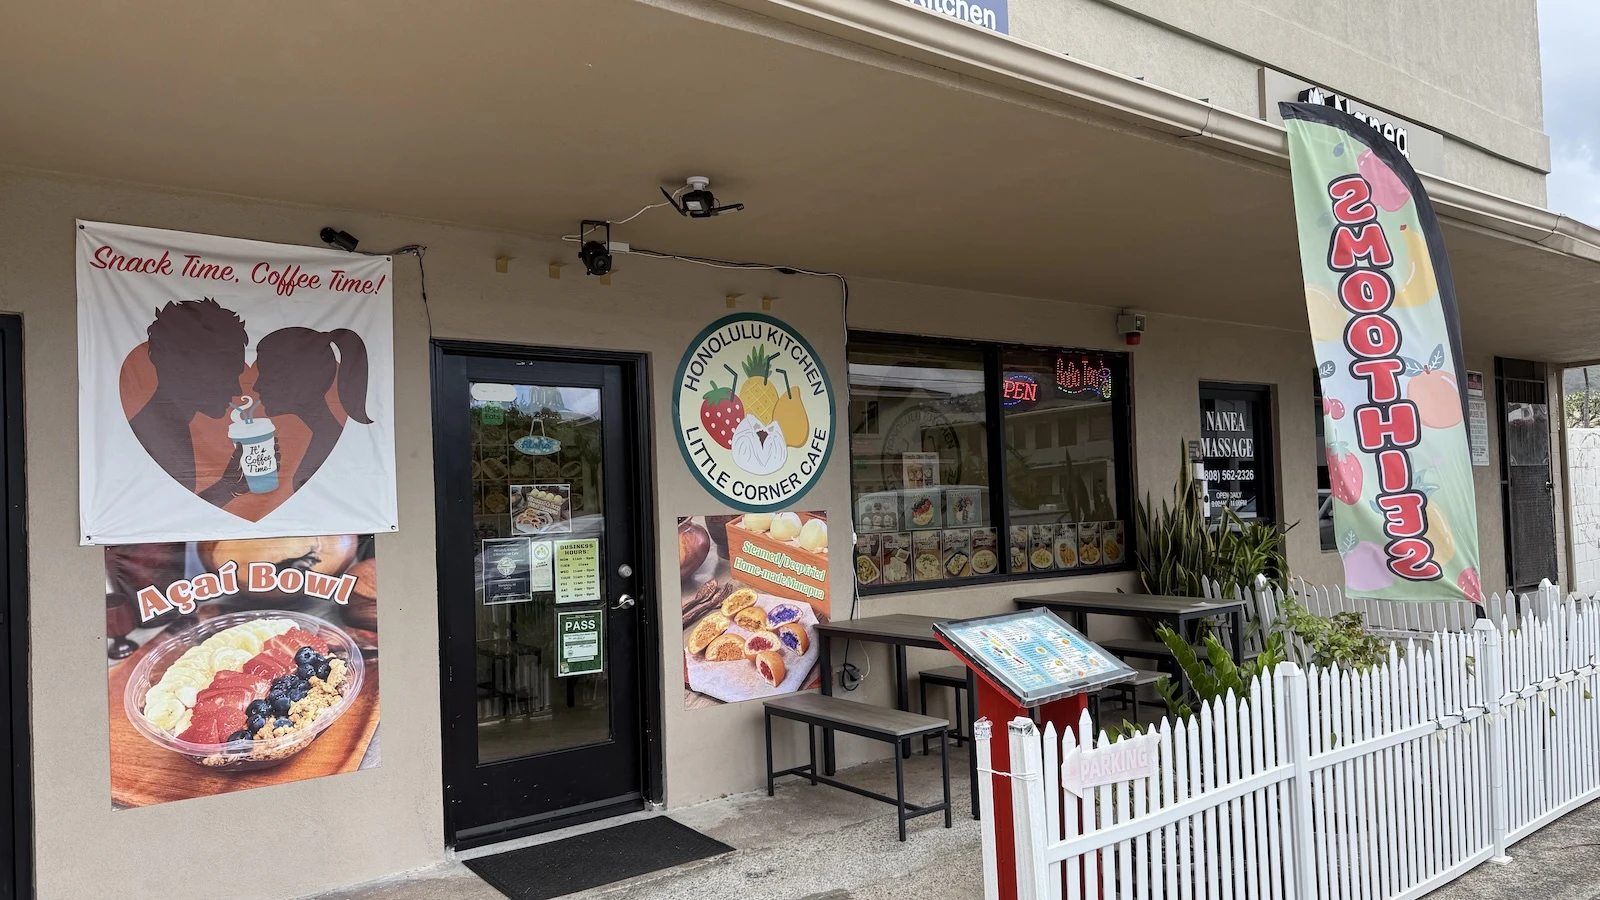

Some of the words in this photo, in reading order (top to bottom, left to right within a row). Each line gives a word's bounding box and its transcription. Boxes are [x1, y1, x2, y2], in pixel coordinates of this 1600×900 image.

[89, 246, 173, 277] Snack
[251, 262, 321, 297] Coffee
[328, 270, 385, 295] Time!
[684, 324, 761, 391] HONOLULU
[767, 327, 825, 396] KITCHEN
[1003, 380, 1038, 401] PEN
[1206, 411, 1245, 431] NANEA
[1201, 438, 1254, 458] MASSAGE
[245, 454, 272, 465] Coffee
[247, 460, 271, 472] Time!
[686, 426, 731, 489] LITTLE
[732, 472, 802, 501] CORNER
[800, 427, 827, 476] CAFE
[1222, 470, 1254, 480] 562-2326
[137, 560, 239, 622] Açaí
[248, 562, 358, 605] Bowl
[565, 619, 596, 631] PASS
[1081, 749, 1149, 780] PARKING
